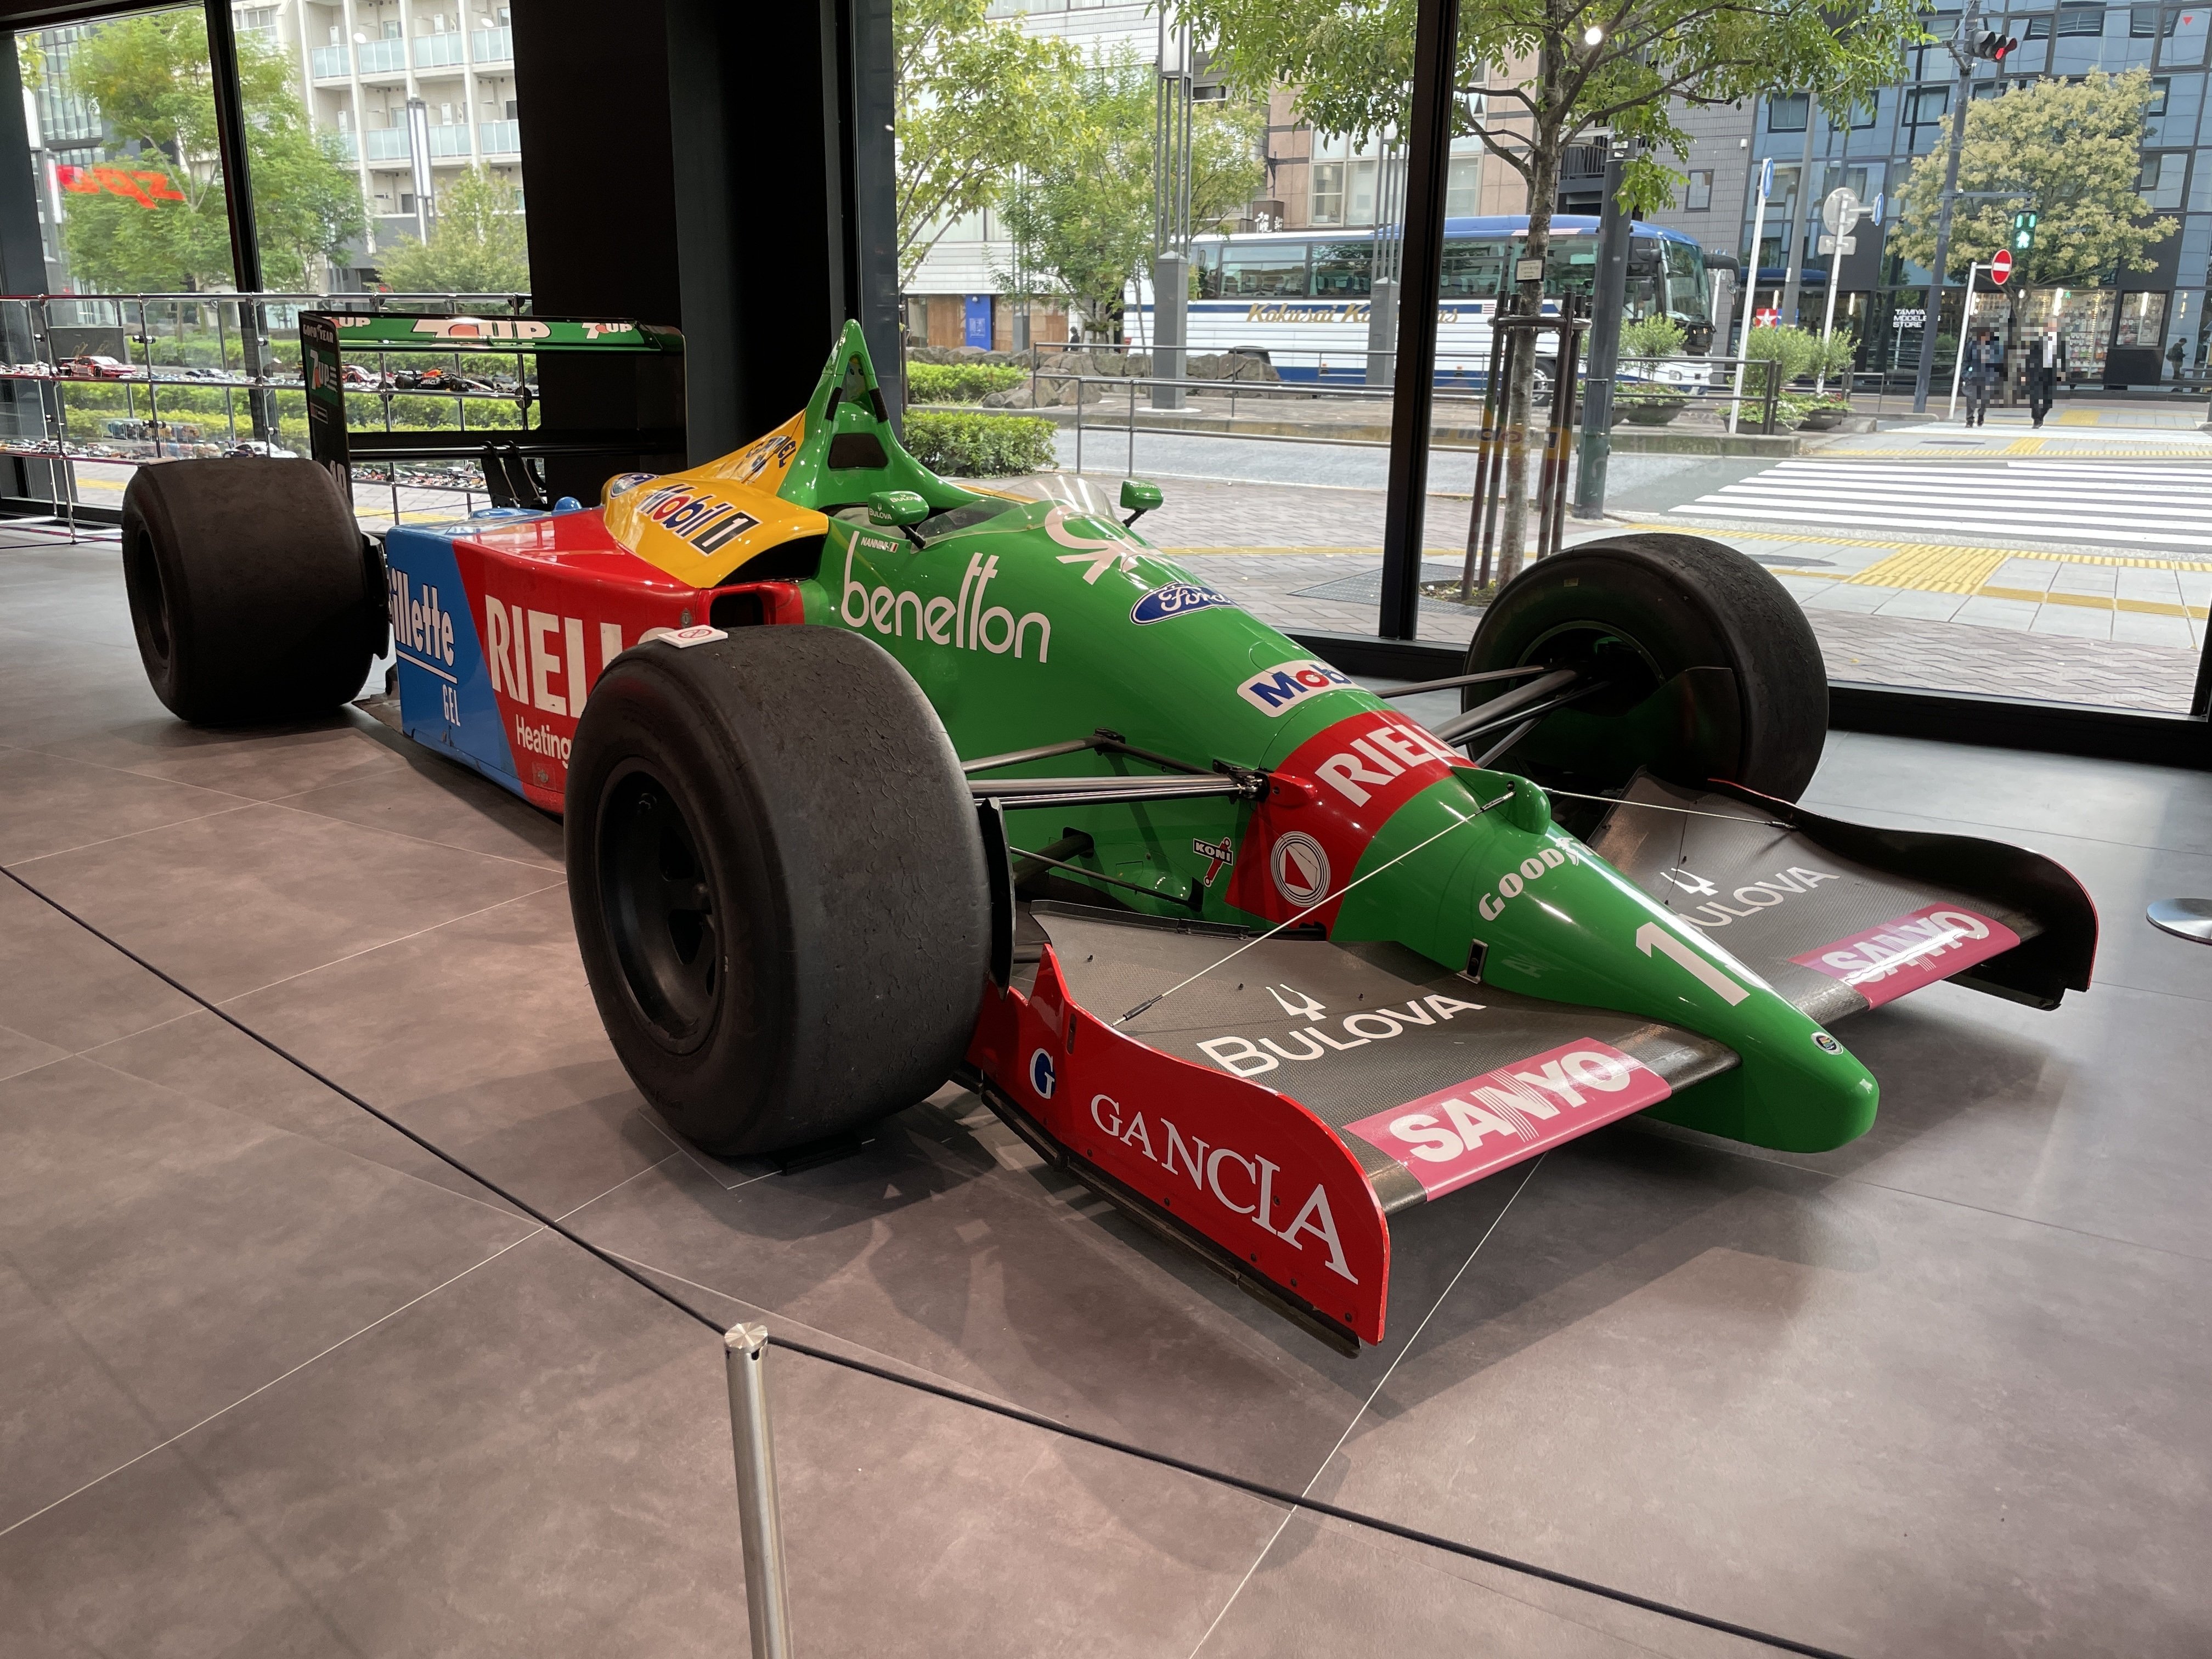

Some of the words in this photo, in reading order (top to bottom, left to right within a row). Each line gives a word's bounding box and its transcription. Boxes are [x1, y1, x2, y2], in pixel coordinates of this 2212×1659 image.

[413, 319, 552, 339] 7UP
[582, 322, 633, 339] 7UP
[1246, 303, 1336, 323] Kokusai
[310, 349, 330, 391] 7UP
[635, 483, 737, 539] Mobil
[869, 509, 893, 521] BULOVA
[390, 567, 455, 667] illette
[841, 531, 1051, 663] benetton
[1158, 586, 1231, 612] Ford
[442, 684, 461, 727] GEL
[1249, 664, 1352, 708] Mob
[515, 714, 572, 769] Heating
[1195, 842, 1231, 861] KONI
[1822, 911, 1990, 983] SANYO
[1197, 994, 1487, 1078] BULOVA
[1029, 1047, 1057, 1099] G
[1389, 1051, 1632, 1164] SANYO
[1090, 1093, 1359, 1285] GANCIA
